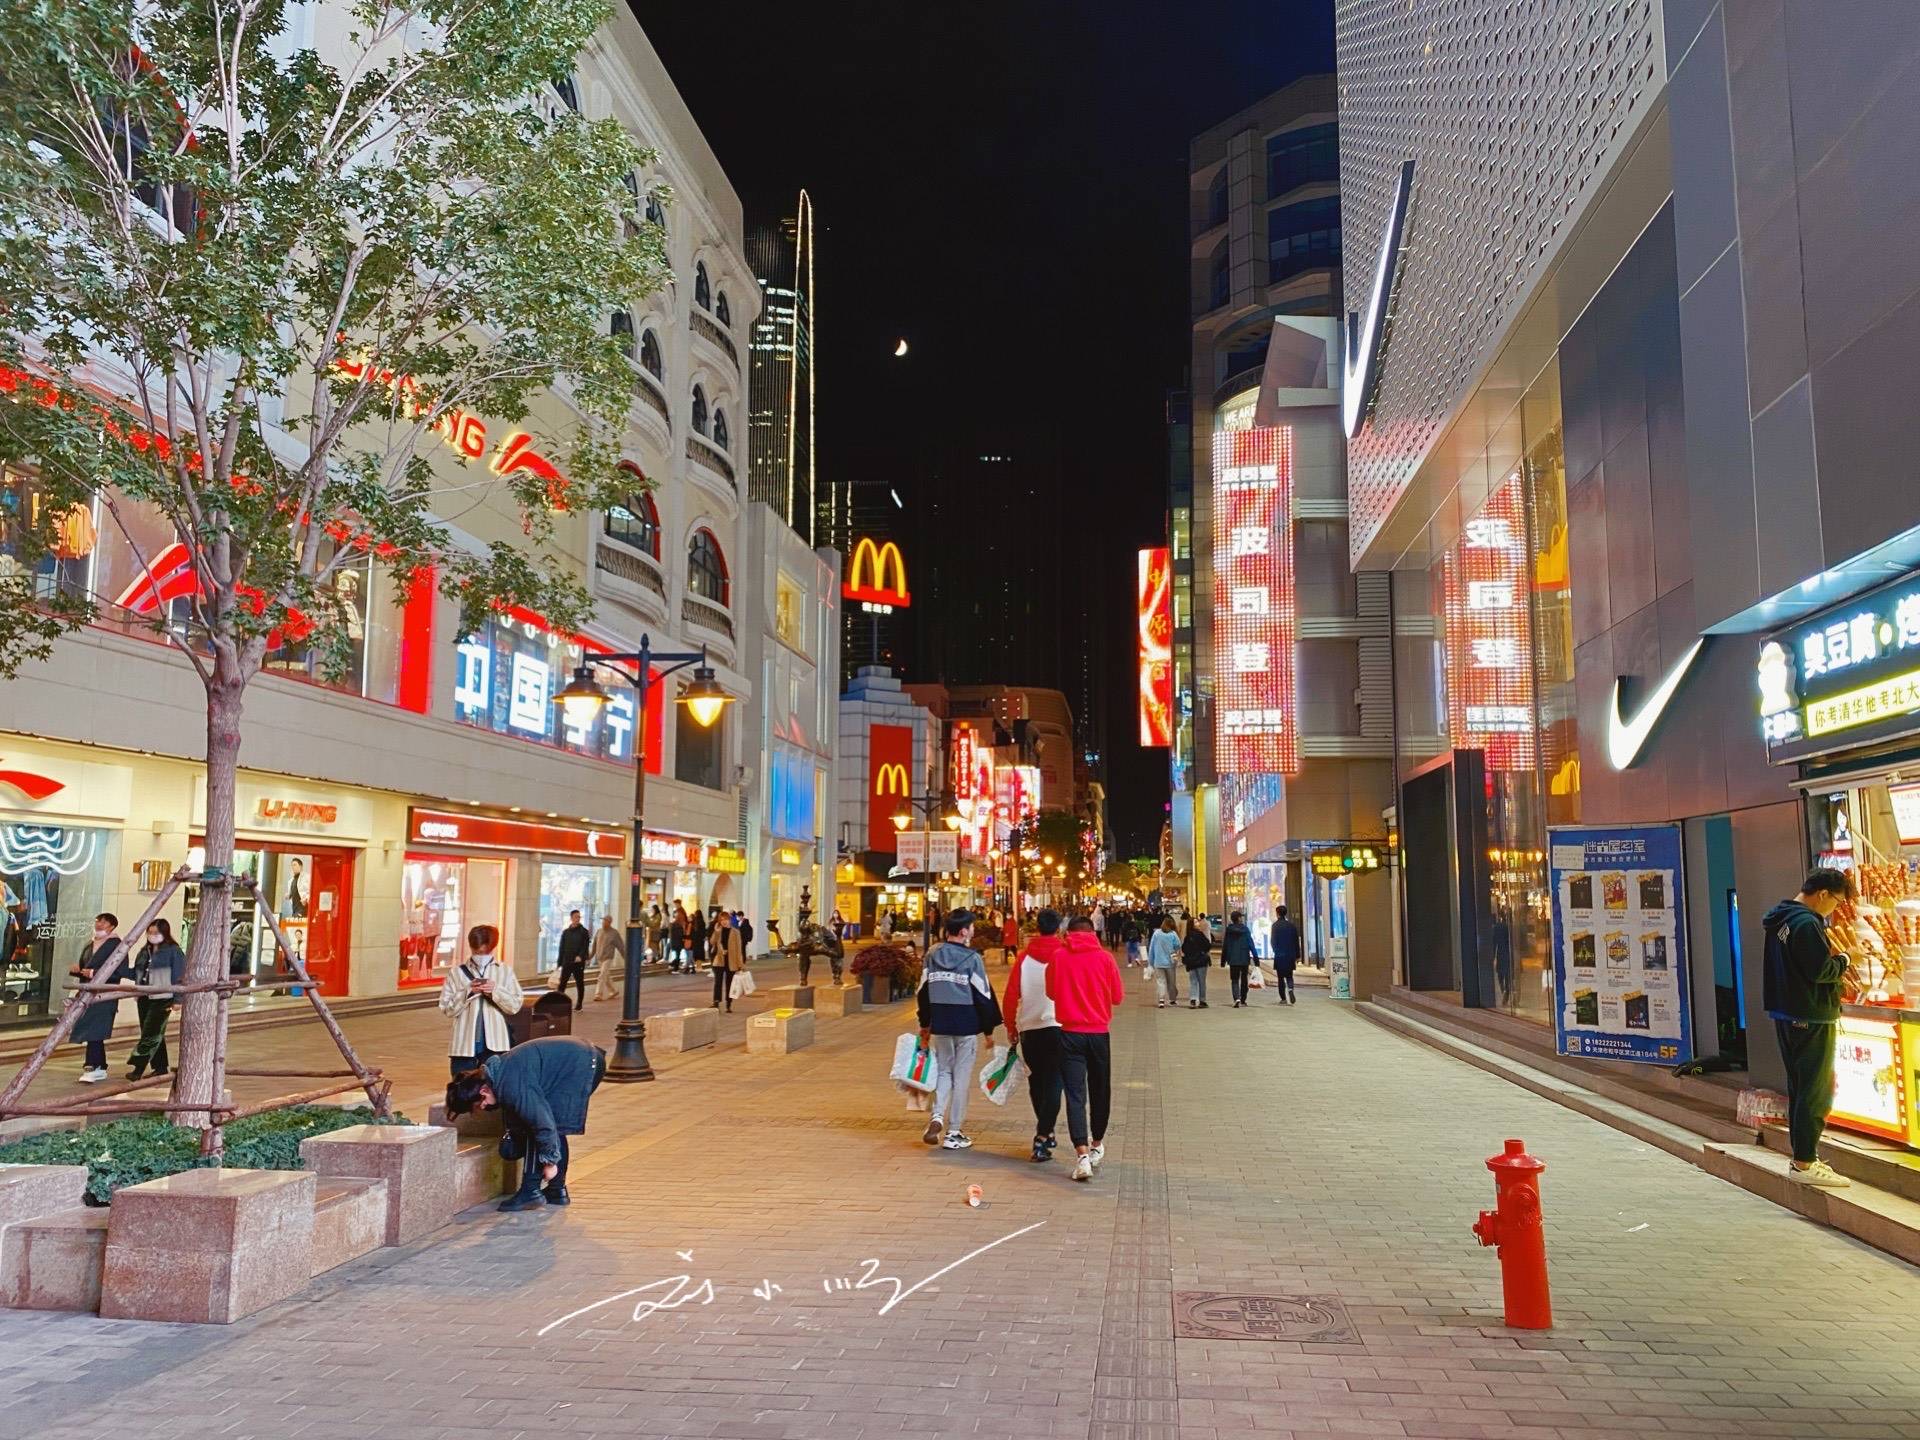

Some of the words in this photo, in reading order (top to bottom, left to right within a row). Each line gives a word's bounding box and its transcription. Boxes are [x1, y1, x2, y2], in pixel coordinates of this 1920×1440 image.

[1815, 680, 1920, 729] 你考清华他考北大
[1660, 1045, 1677, 1060] 5F
